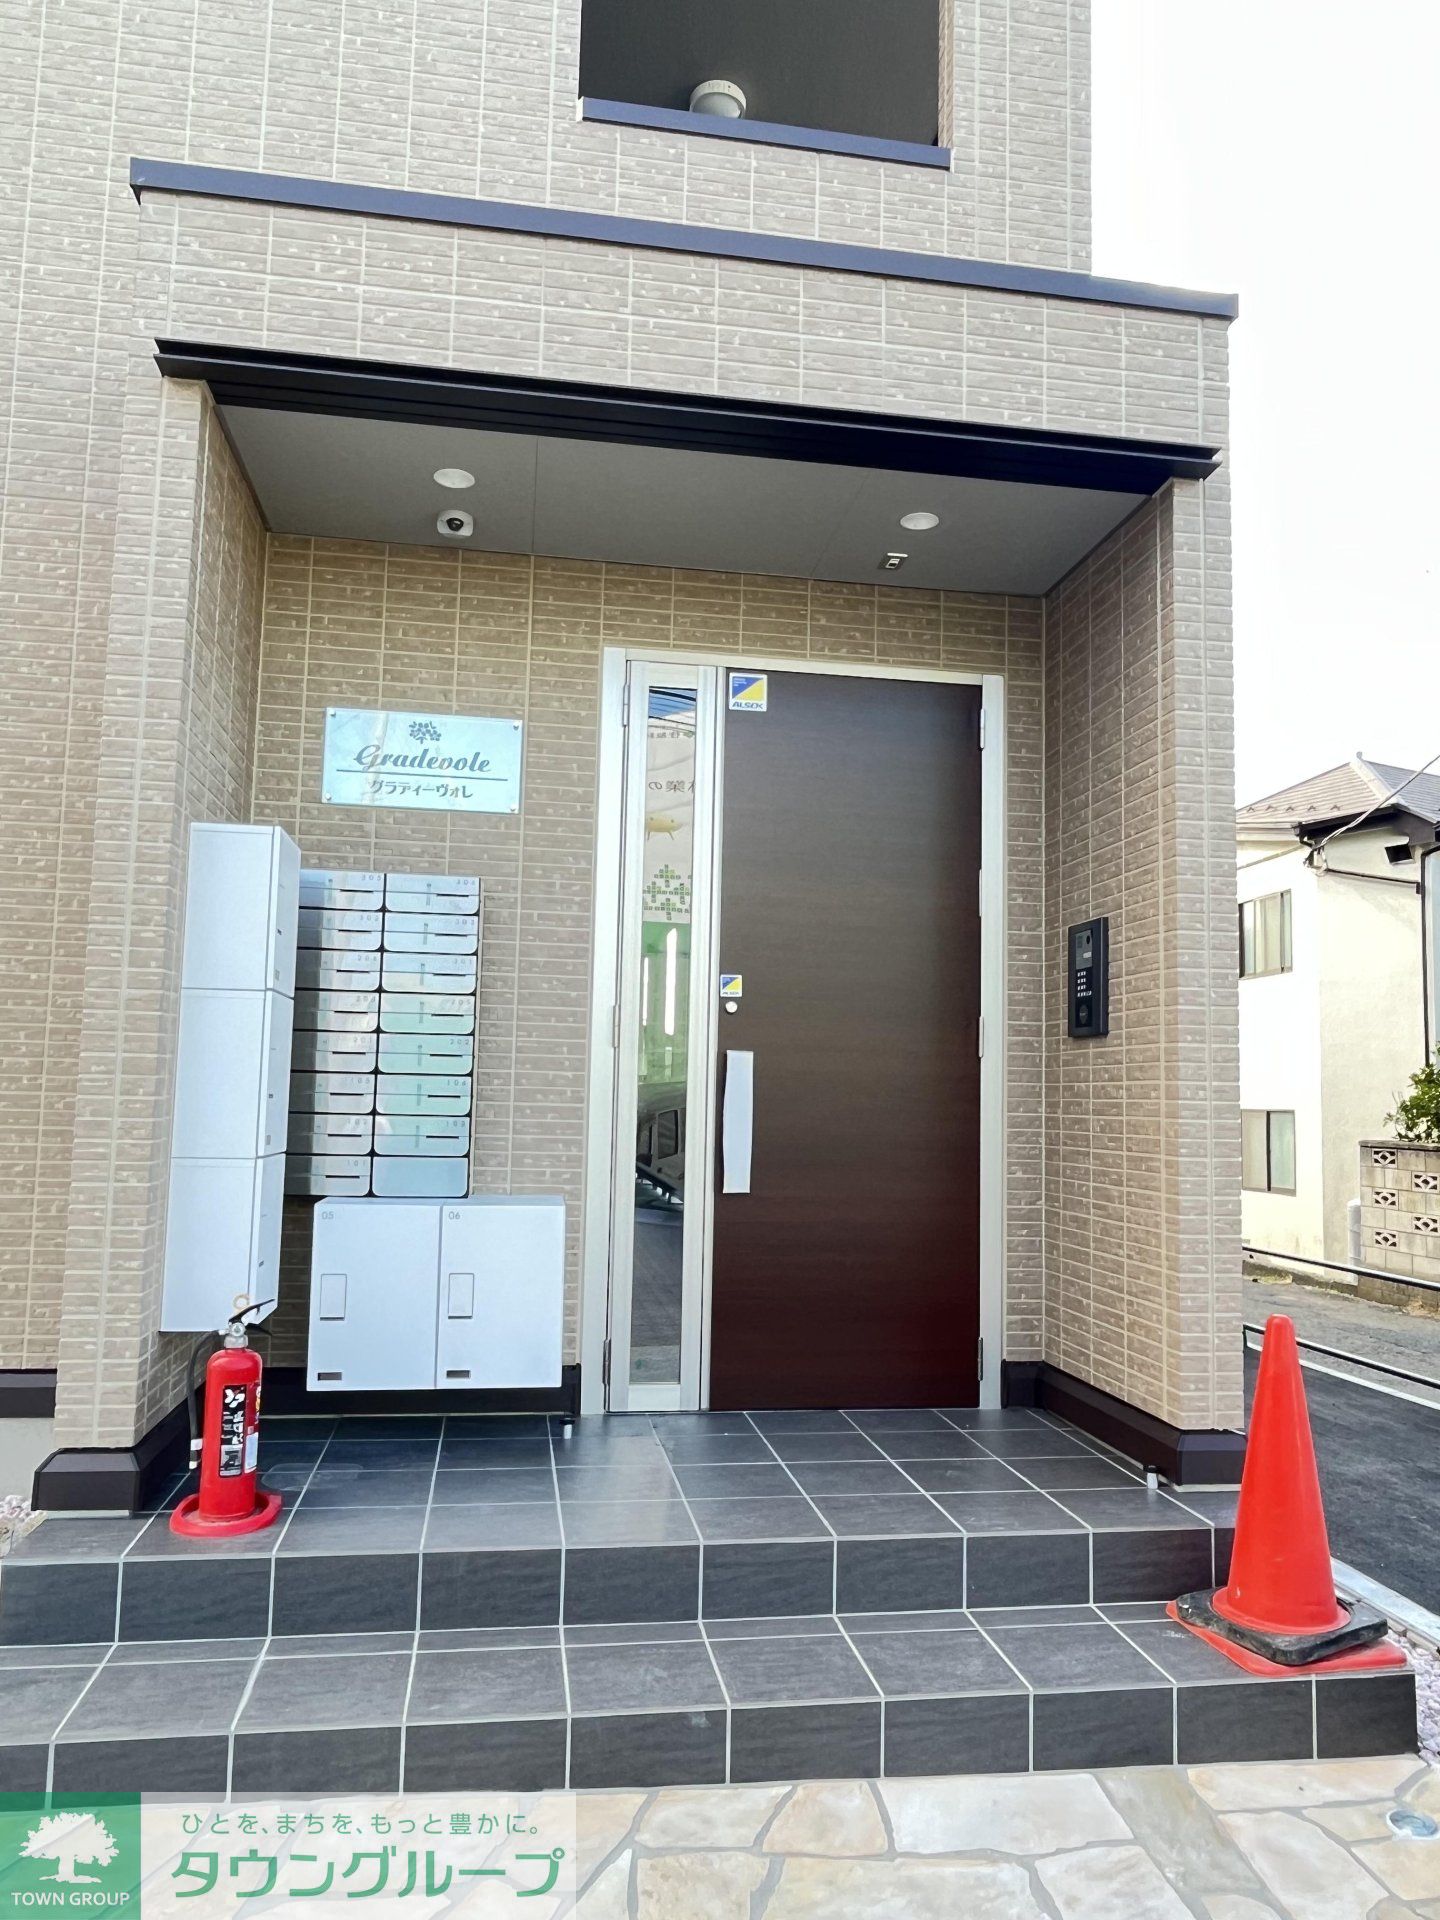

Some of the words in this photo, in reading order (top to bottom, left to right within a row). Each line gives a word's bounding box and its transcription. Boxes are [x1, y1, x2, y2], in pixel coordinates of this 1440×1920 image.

[732, 701, 764, 710] ALSOK
[353, 744, 492, 773] Gradevole
[321, 1211, 334, 1221] 05
[448, 1211, 461, 1221] 06
